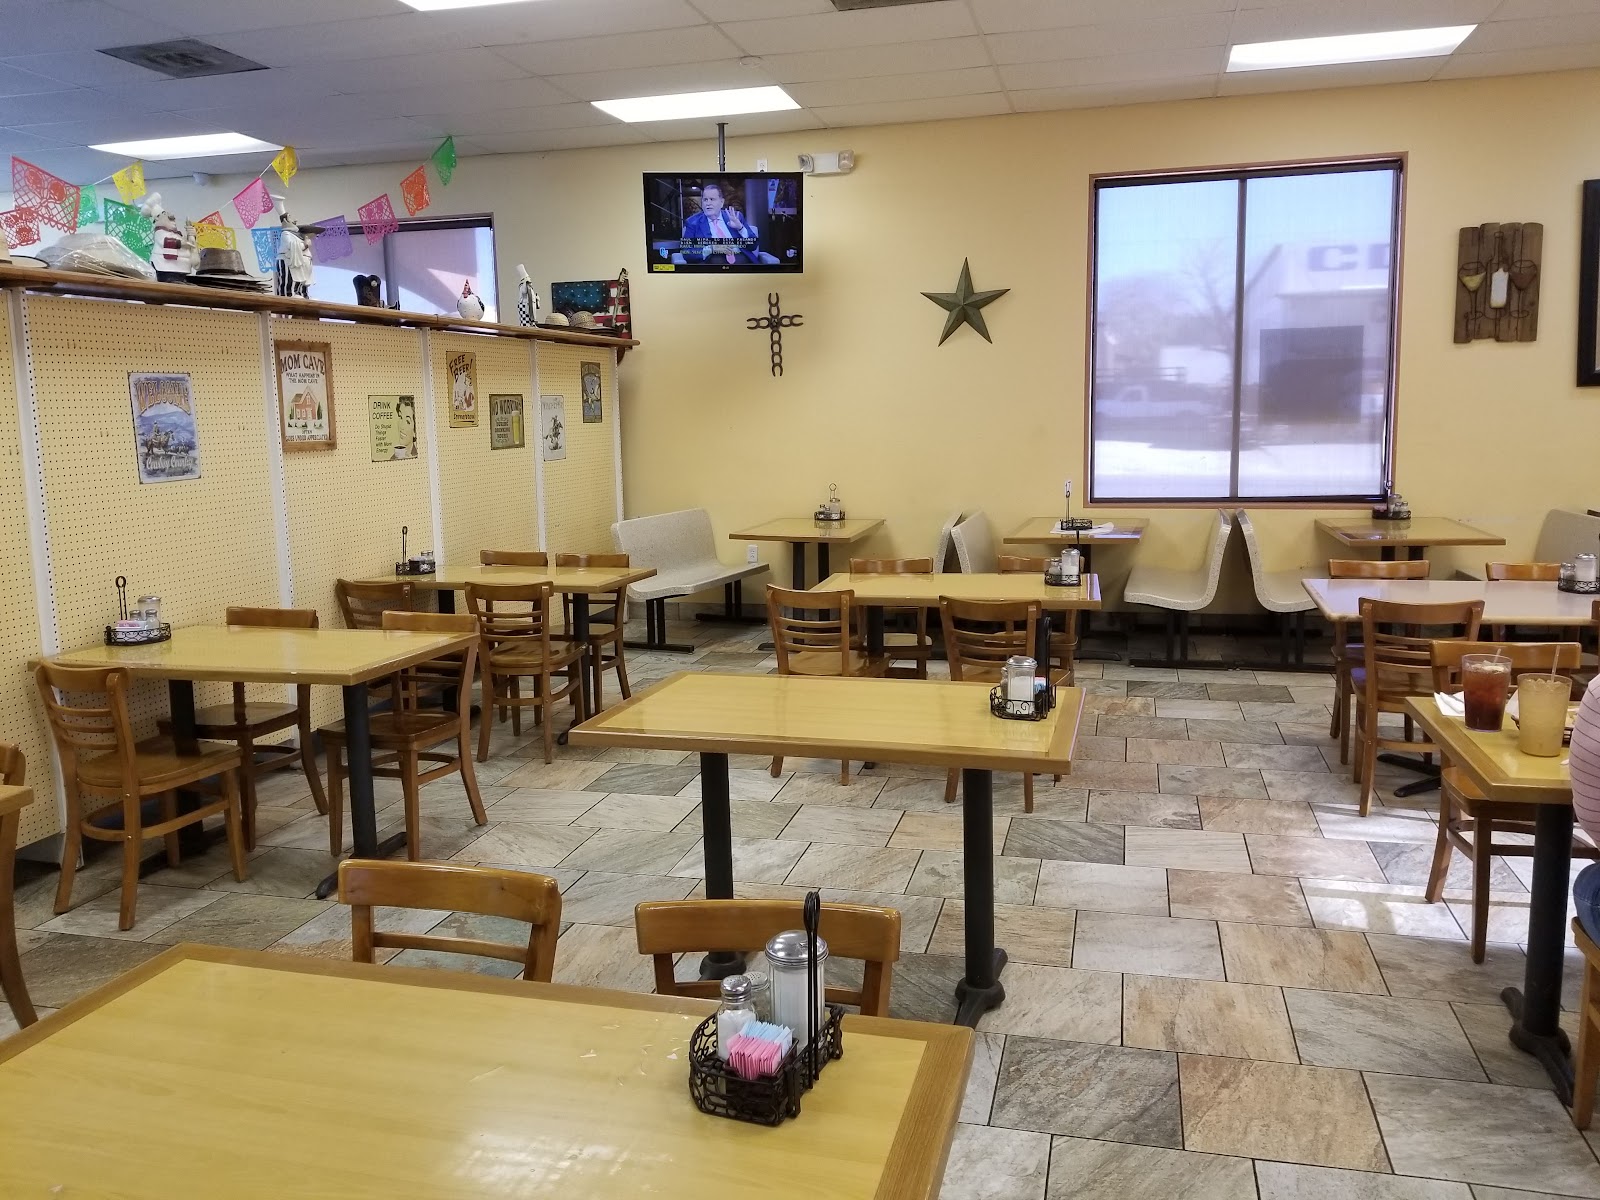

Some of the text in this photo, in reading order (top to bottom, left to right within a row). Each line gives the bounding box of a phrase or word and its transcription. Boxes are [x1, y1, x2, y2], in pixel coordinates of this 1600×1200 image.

[280, 354, 325, 376] MOM CAVE
[449, 354, 466, 377] FREE
[453, 358, 473, 384] BEER!
[372, 411, 393, 420] COFFEE
[373, 401, 391, 410] DRINK
